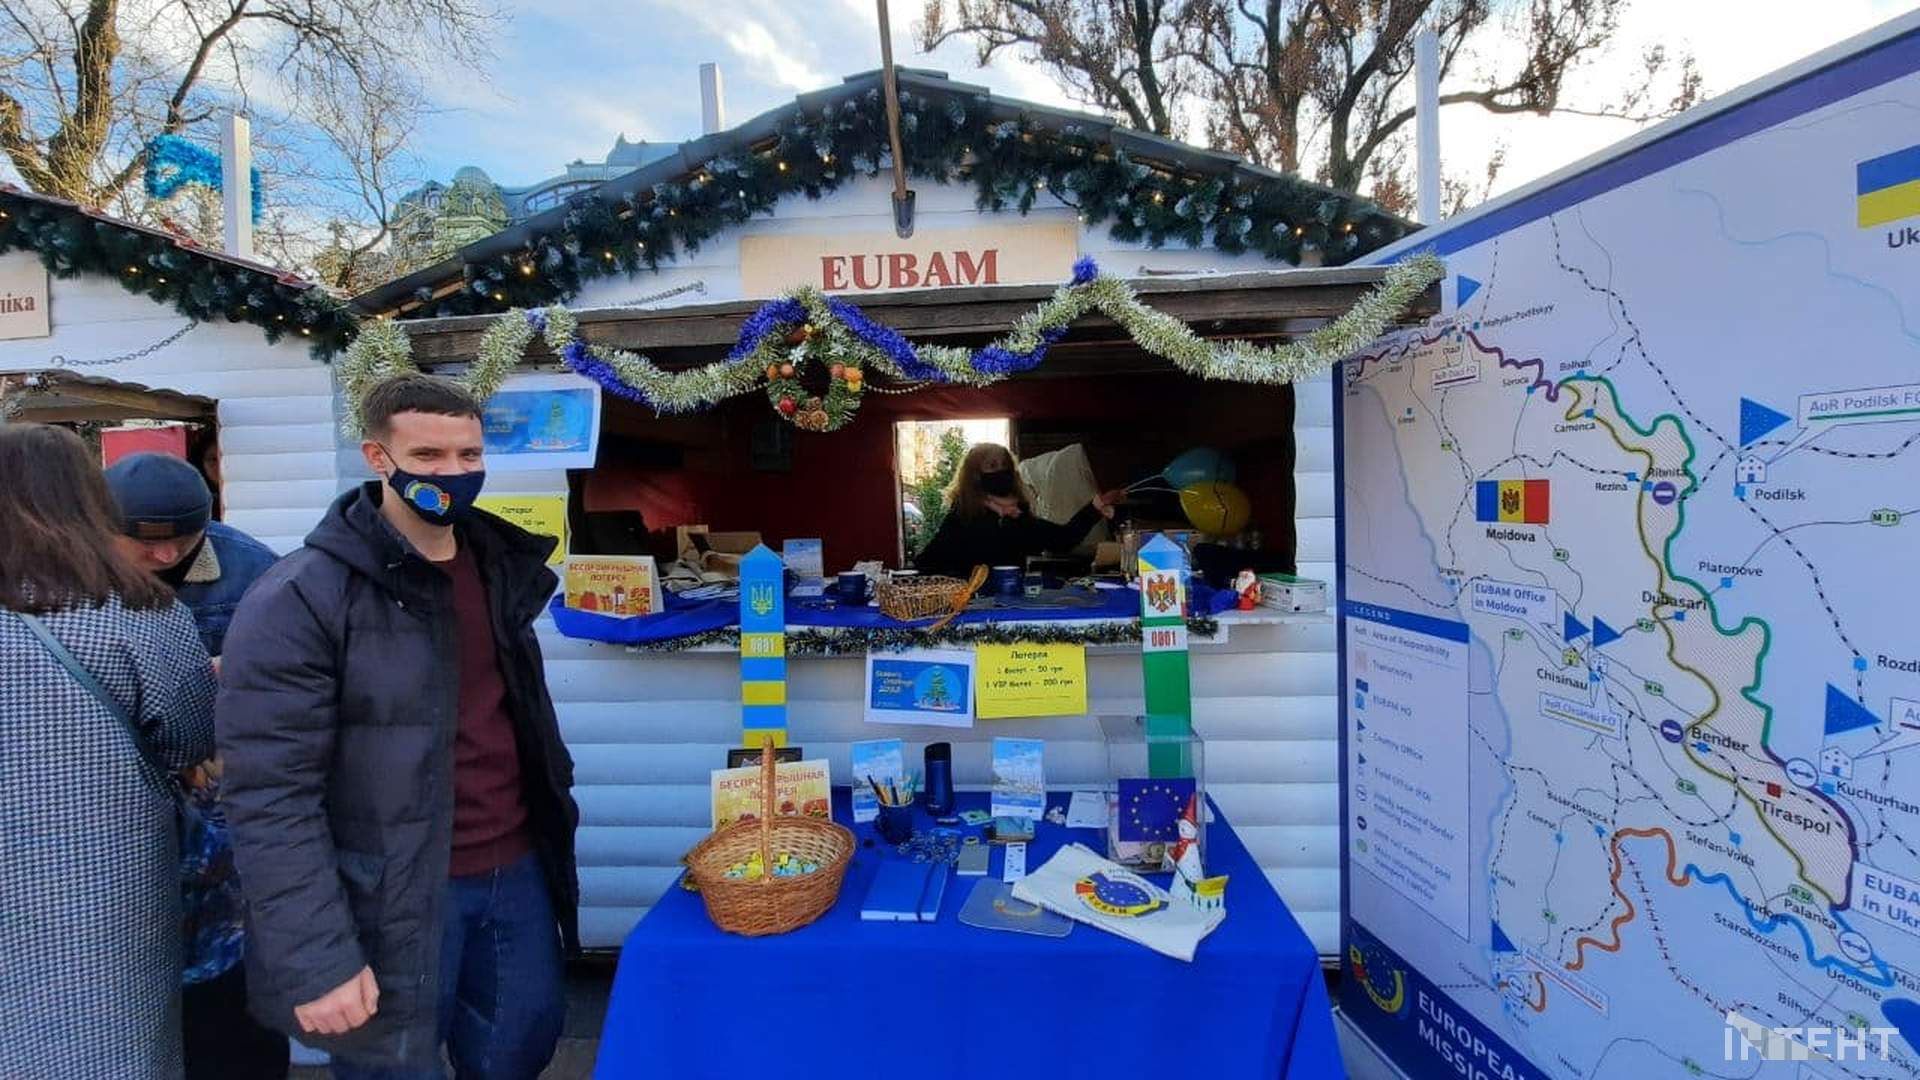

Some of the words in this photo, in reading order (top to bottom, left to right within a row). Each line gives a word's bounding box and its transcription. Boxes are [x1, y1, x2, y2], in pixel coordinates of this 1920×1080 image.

[821, 249, 999, 291] EUBAM
[1809, 397, 1840, 412] AoR
[1844, 392, 1899, 409] Podilsk
[1594, 481, 1629, 492] Rezina
[1755, 487, 1807, 501] Podilsk
[1485, 527, 1537, 544] Moldova
[1699, 561, 1764, 577] Platonove
[1475, 583, 1511, 598] EUBAM
[1513, 588, 1547, 603] Office
[1475, 598, 1484, 608] in
[1486, 600, 1528, 615] Moldova
[1537, 668, 1589, 691] Chisinau
[1691, 727, 1751, 753] Bender
[1759, 798, 1831, 835] Tiraspol
[1685, 830, 1755, 868] Stefan-Voda
[1862, 894, 1880, 912] in
[1713, 912, 1801, 963] Starokozache
[1826, 967, 1882, 1001] Udobne
[1418, 991, 1525, 1080] EUROPEA
